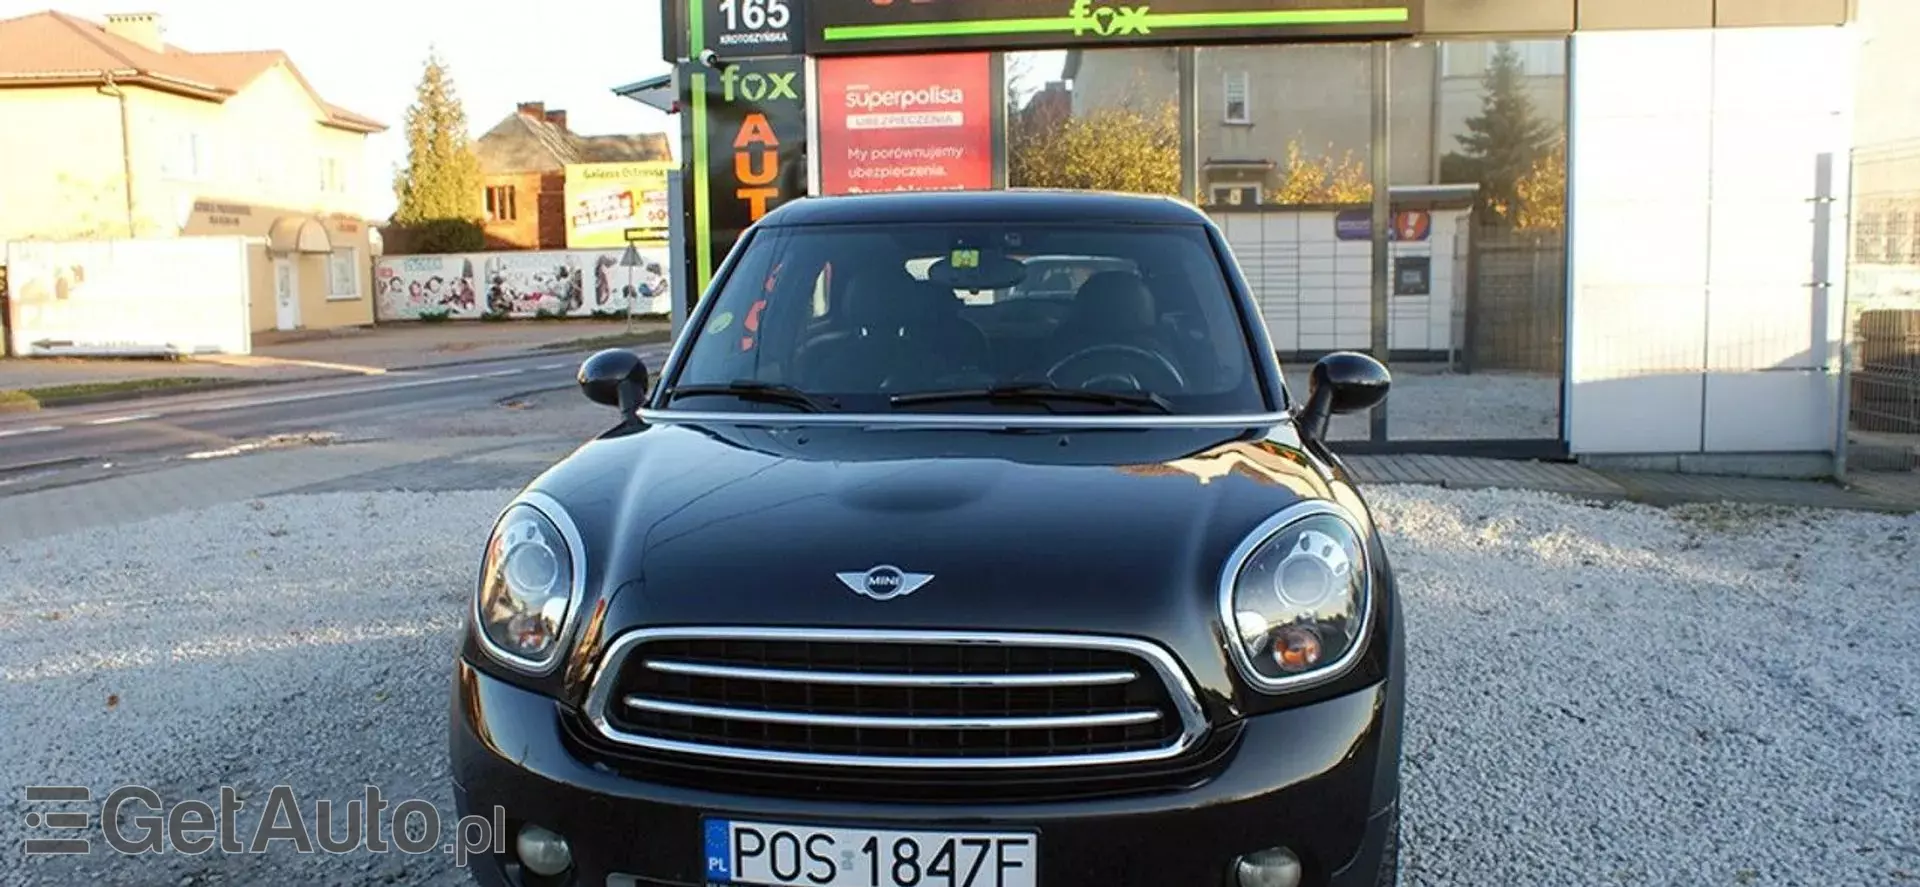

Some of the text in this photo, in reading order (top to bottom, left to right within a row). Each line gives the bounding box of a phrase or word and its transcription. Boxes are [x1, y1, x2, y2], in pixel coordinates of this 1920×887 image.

[719, 0, 790, 30] 165
[1069, 0, 1150, 36] fox
[720, 64, 798, 101] fox
[845, 84, 964, 111] superpolisa
[848, 146, 965, 161] My porównujemy
[868, 575, 900, 586] MINI
[708, 856, 728, 872] PL
[733, 827, 837, 884] POS
